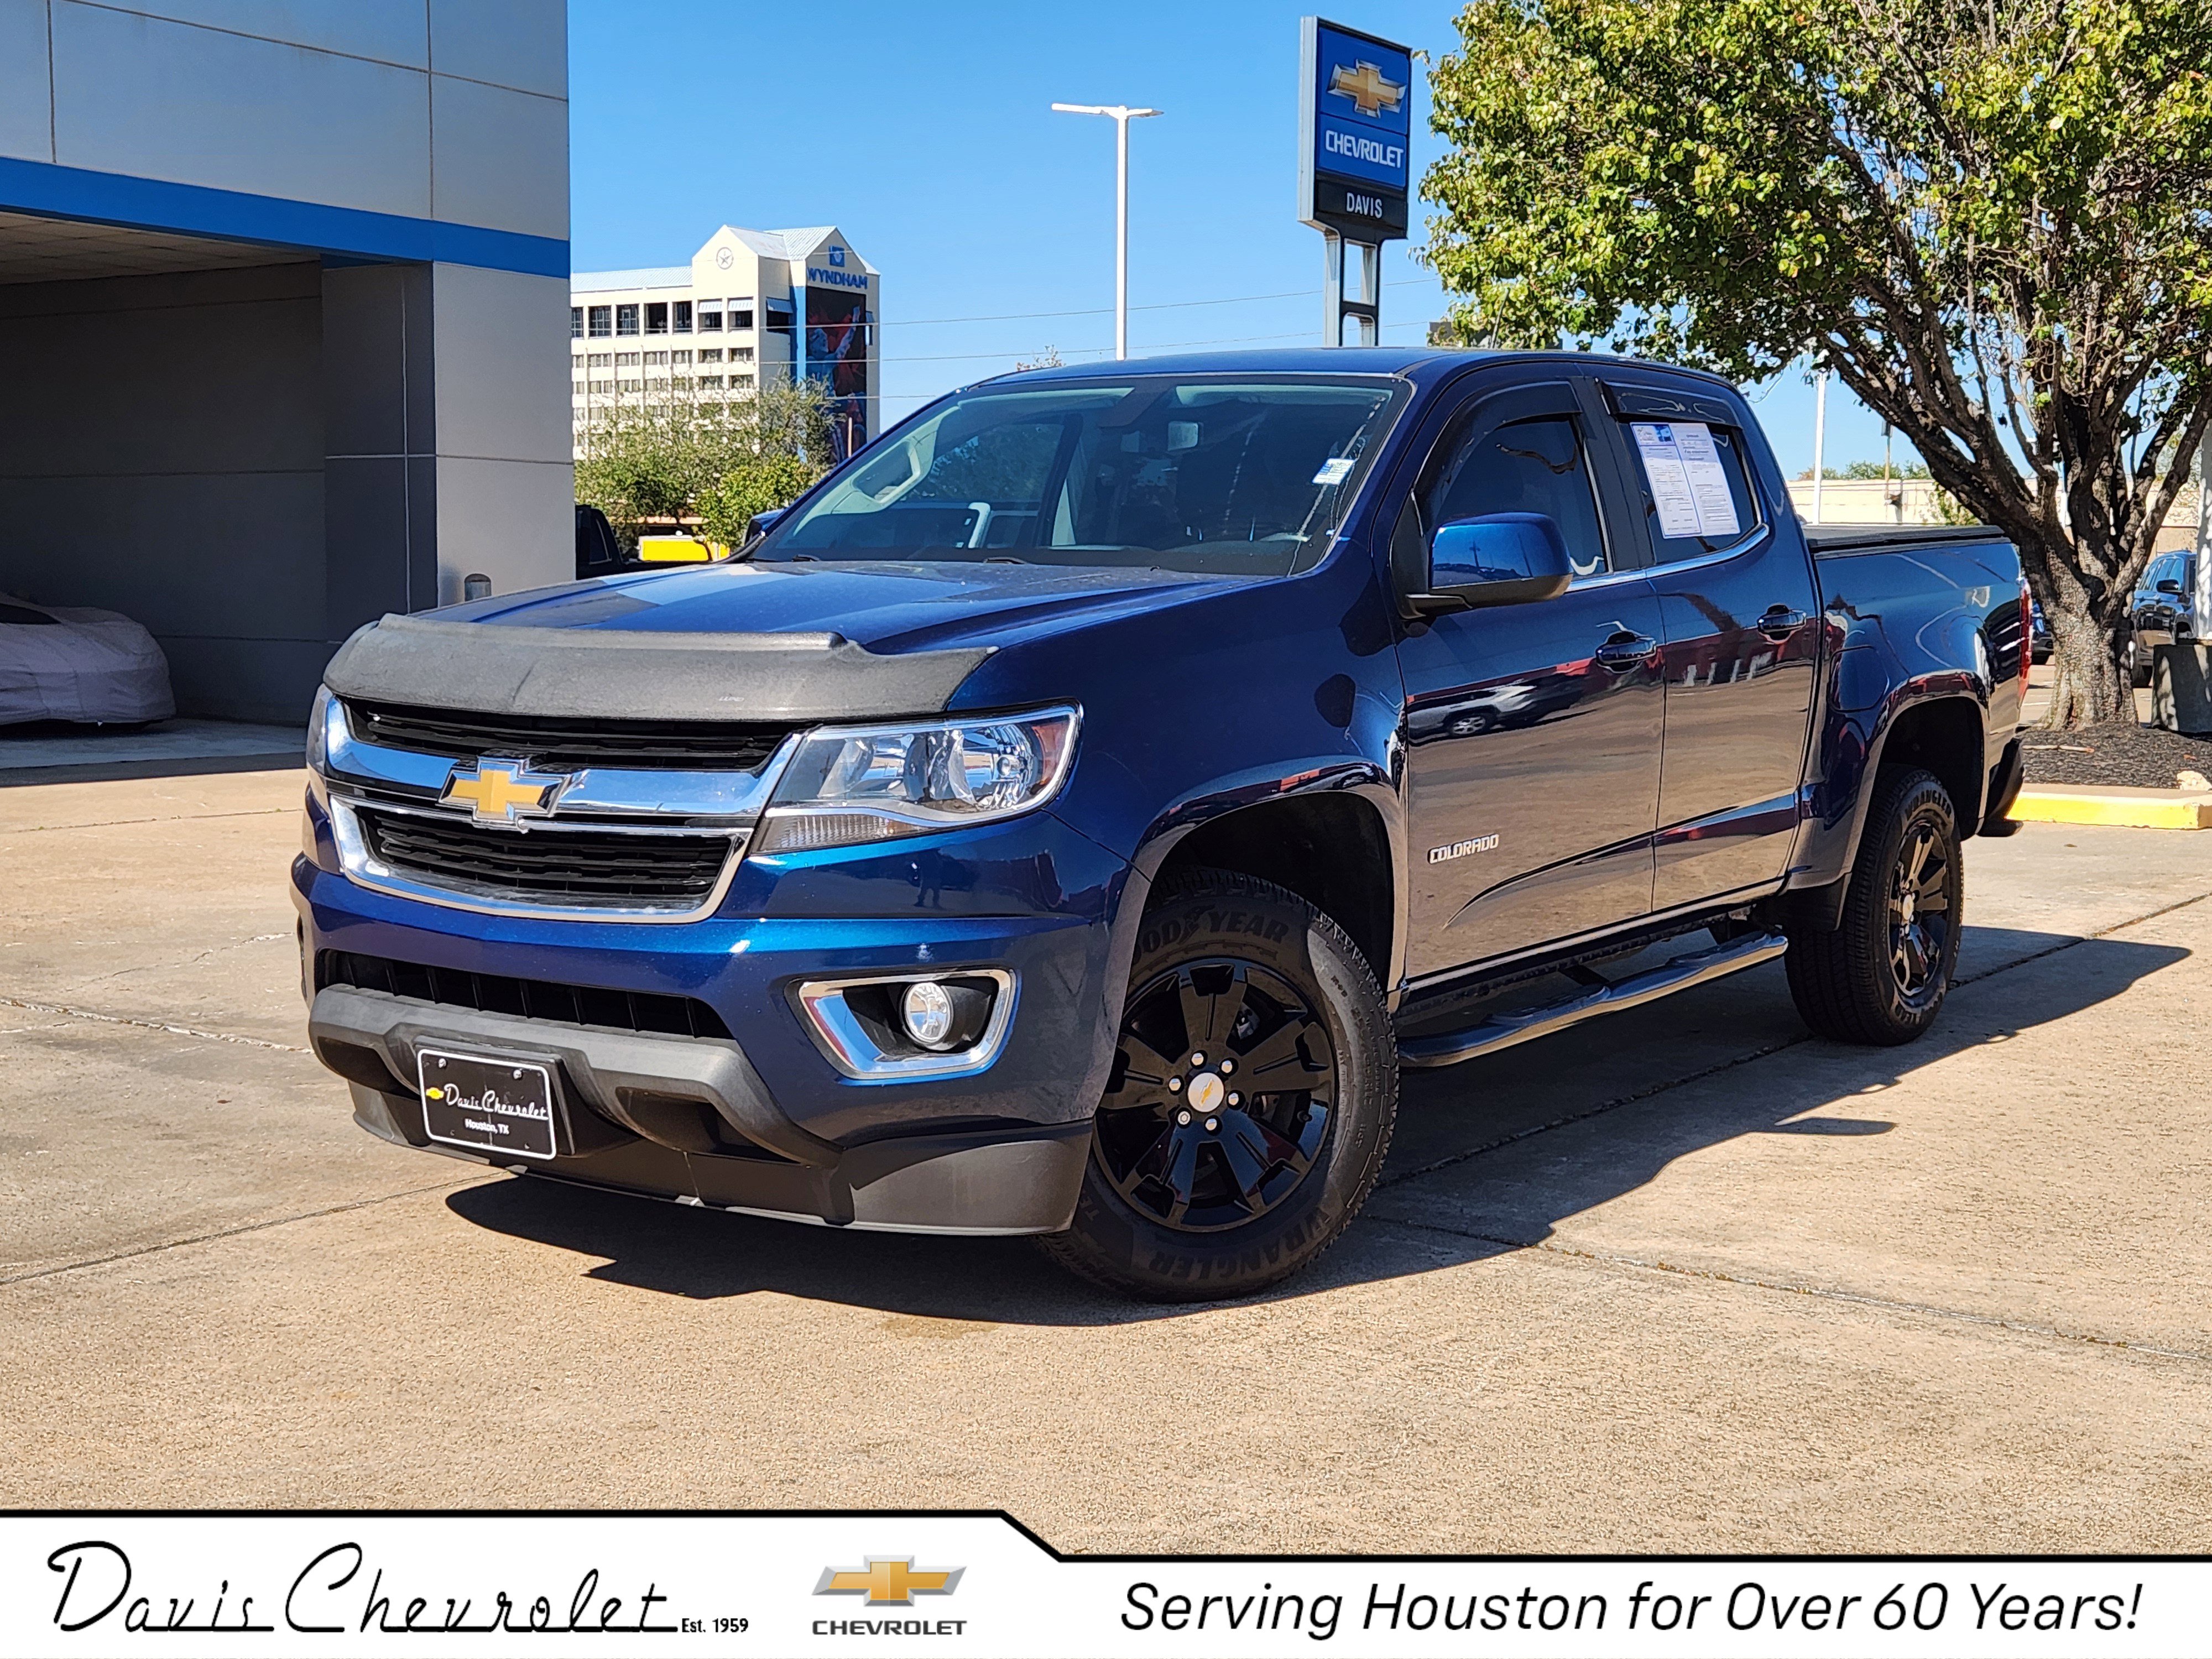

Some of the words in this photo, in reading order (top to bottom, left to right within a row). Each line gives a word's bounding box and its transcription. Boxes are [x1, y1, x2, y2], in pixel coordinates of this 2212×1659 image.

[1326, 129, 1404, 168] CHEVROLET
[1346, 192, 1383, 218] DAVIS
[807, 267, 868, 290] WYNDHAM
[1429, 833, 1500, 864] COLORADO
[1208, 911, 1290, 945] YEAR
[444, 1083, 482, 1109] Davis
[482, 1090, 549, 1120] Chevrolet
[465, 1119, 498, 1134] Houston,
[497, 1124, 509, 1134] TX
[1149, 1207, 1332, 1280] WRANGLER
